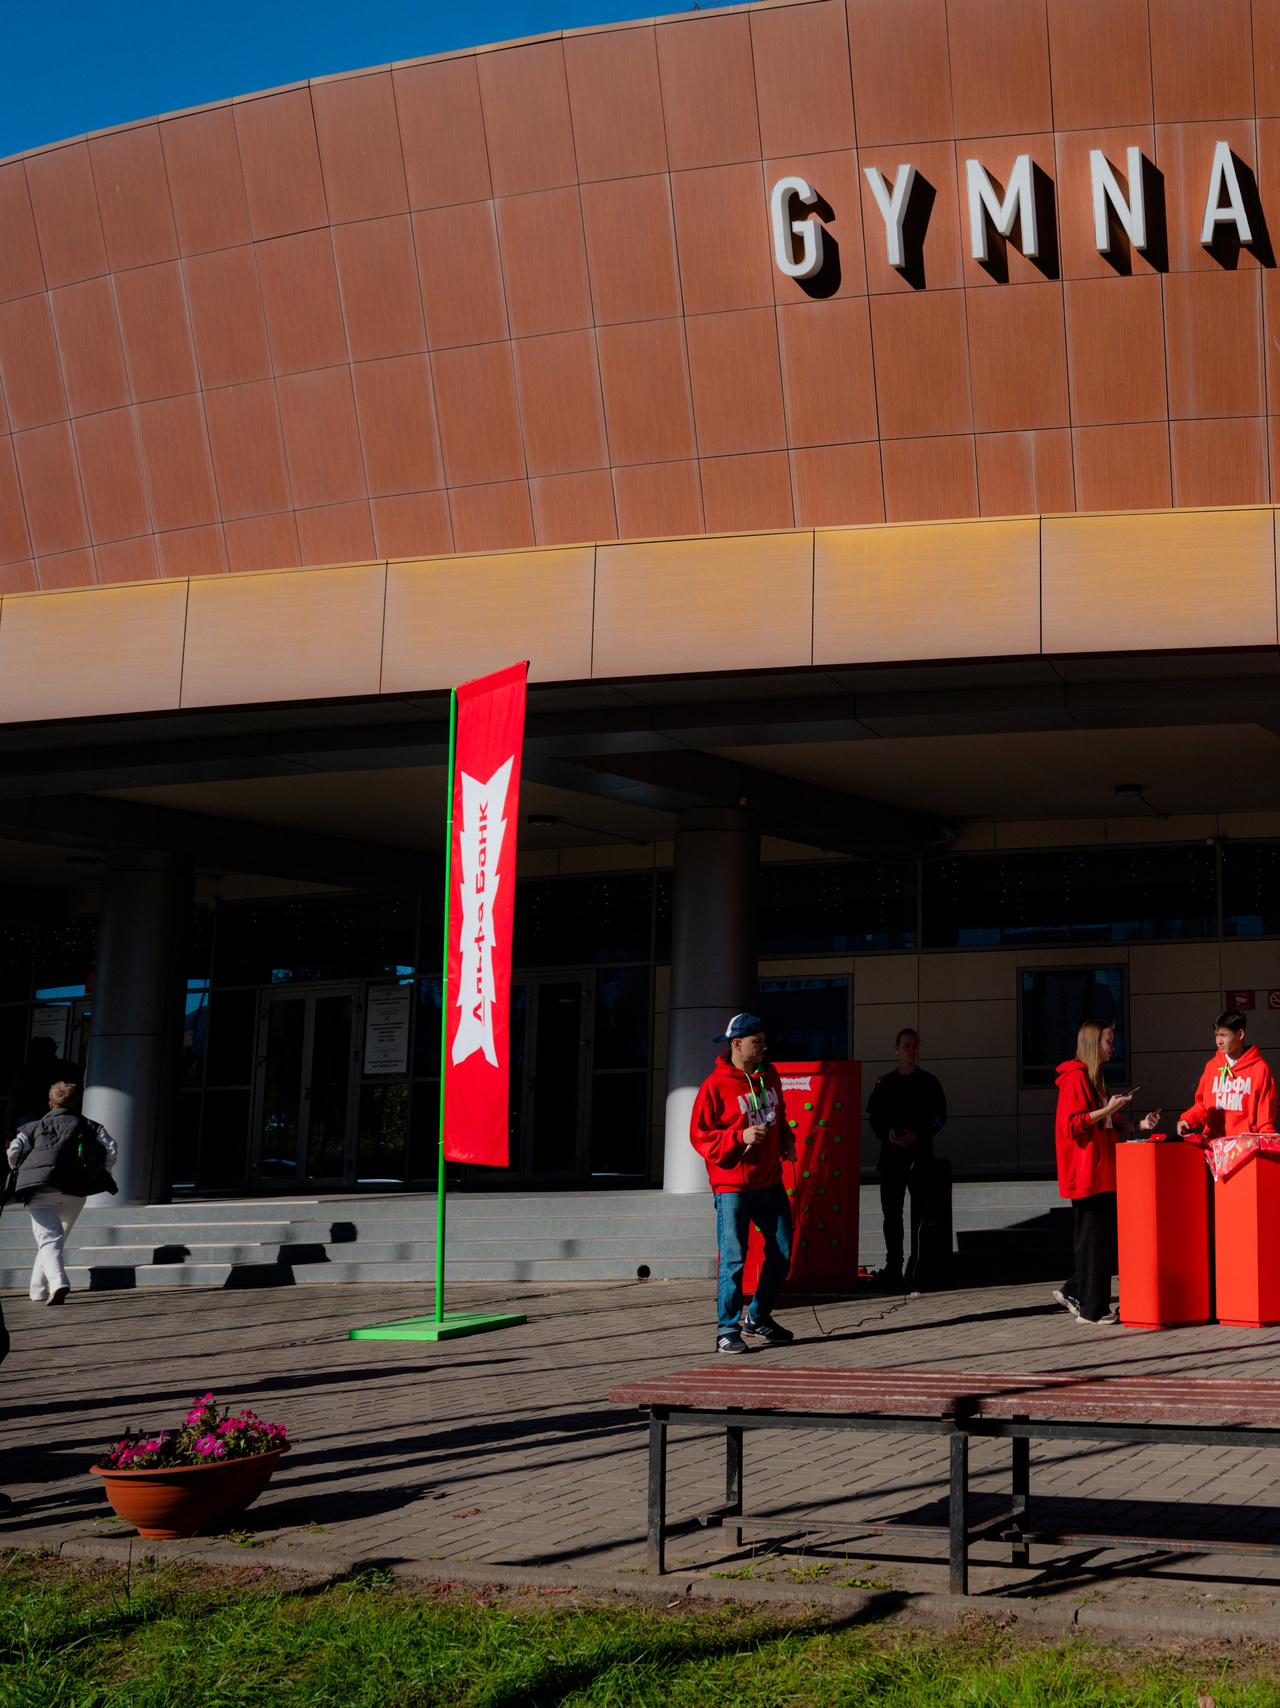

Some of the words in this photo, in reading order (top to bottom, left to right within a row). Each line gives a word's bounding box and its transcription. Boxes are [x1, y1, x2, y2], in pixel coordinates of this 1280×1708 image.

[475, 799, 489, 895] Банк
[1211, 1076, 1252, 1095] АЛЬФА
[1215, 1093, 1244, 1112] БАНК
